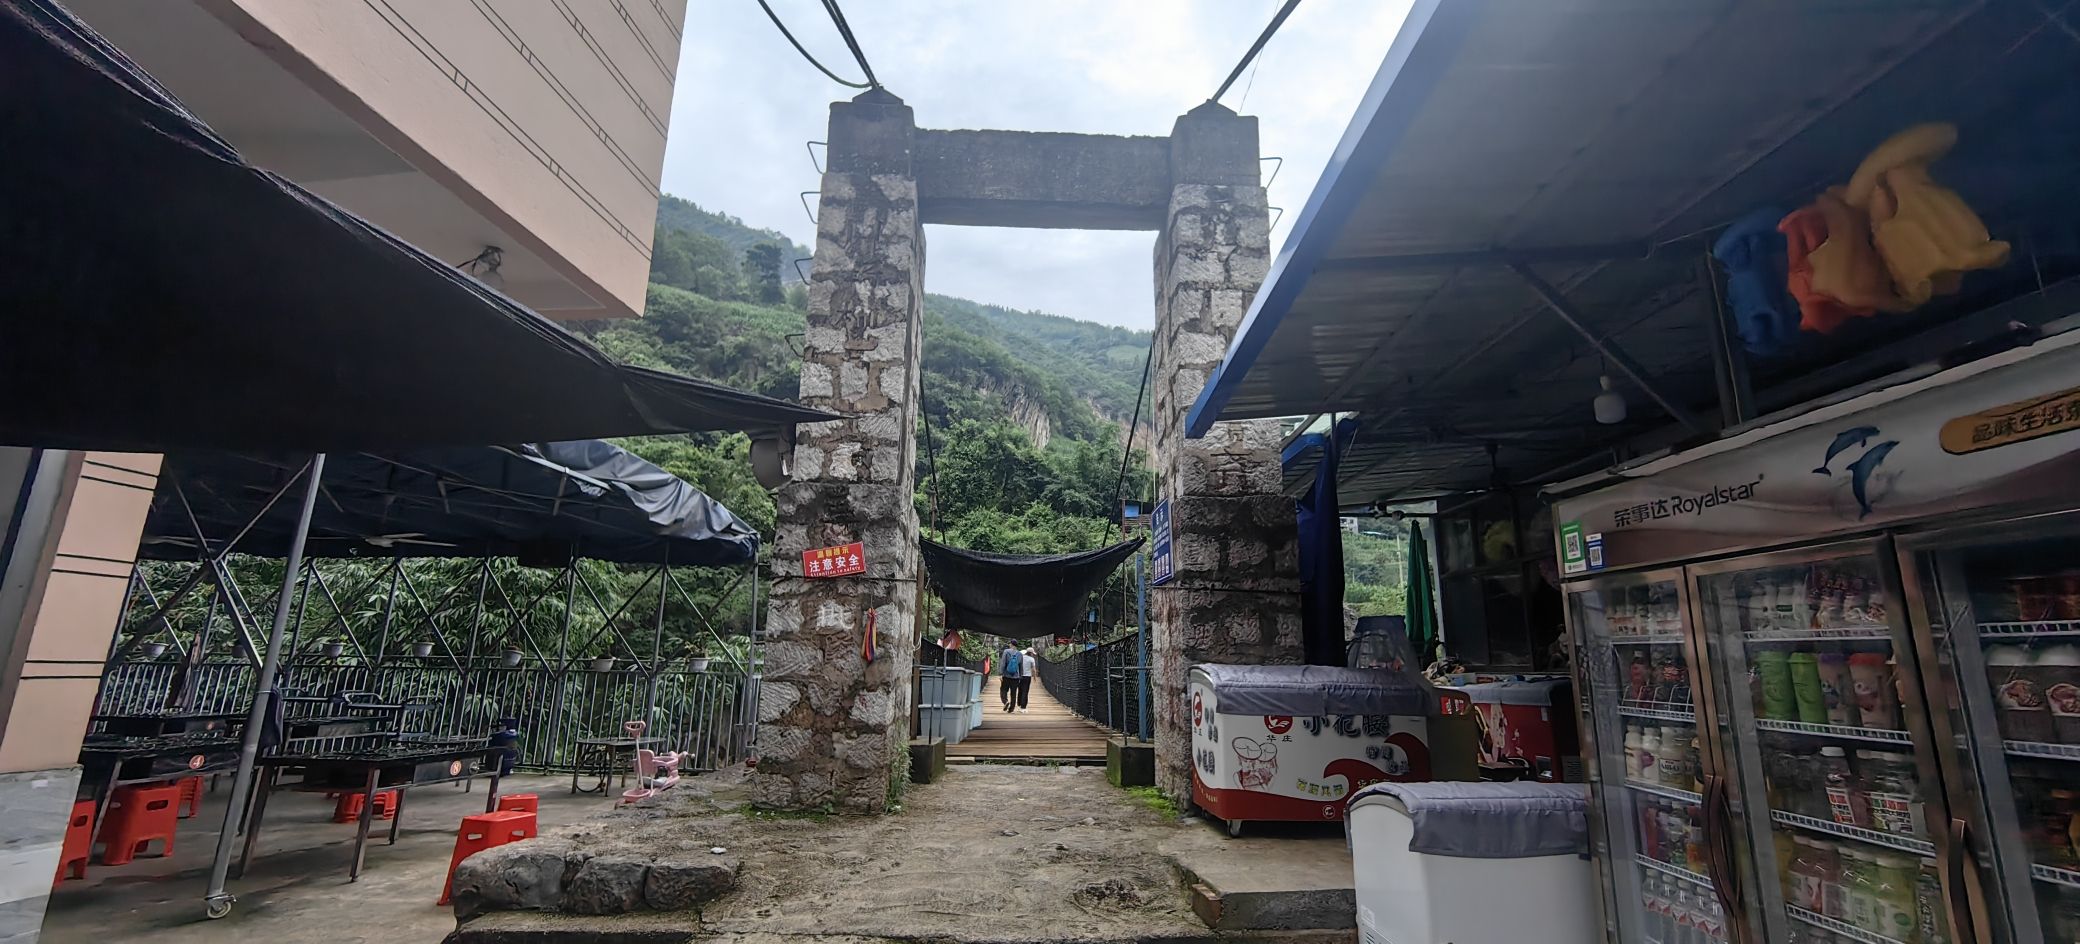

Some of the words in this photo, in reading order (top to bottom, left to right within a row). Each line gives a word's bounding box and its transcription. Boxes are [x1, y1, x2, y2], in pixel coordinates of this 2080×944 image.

[1671, 481, 1761, 515] Royalstar
[1614, 499, 1670, 528] 荣事达
[809, 554, 860, 573] 注意安全
